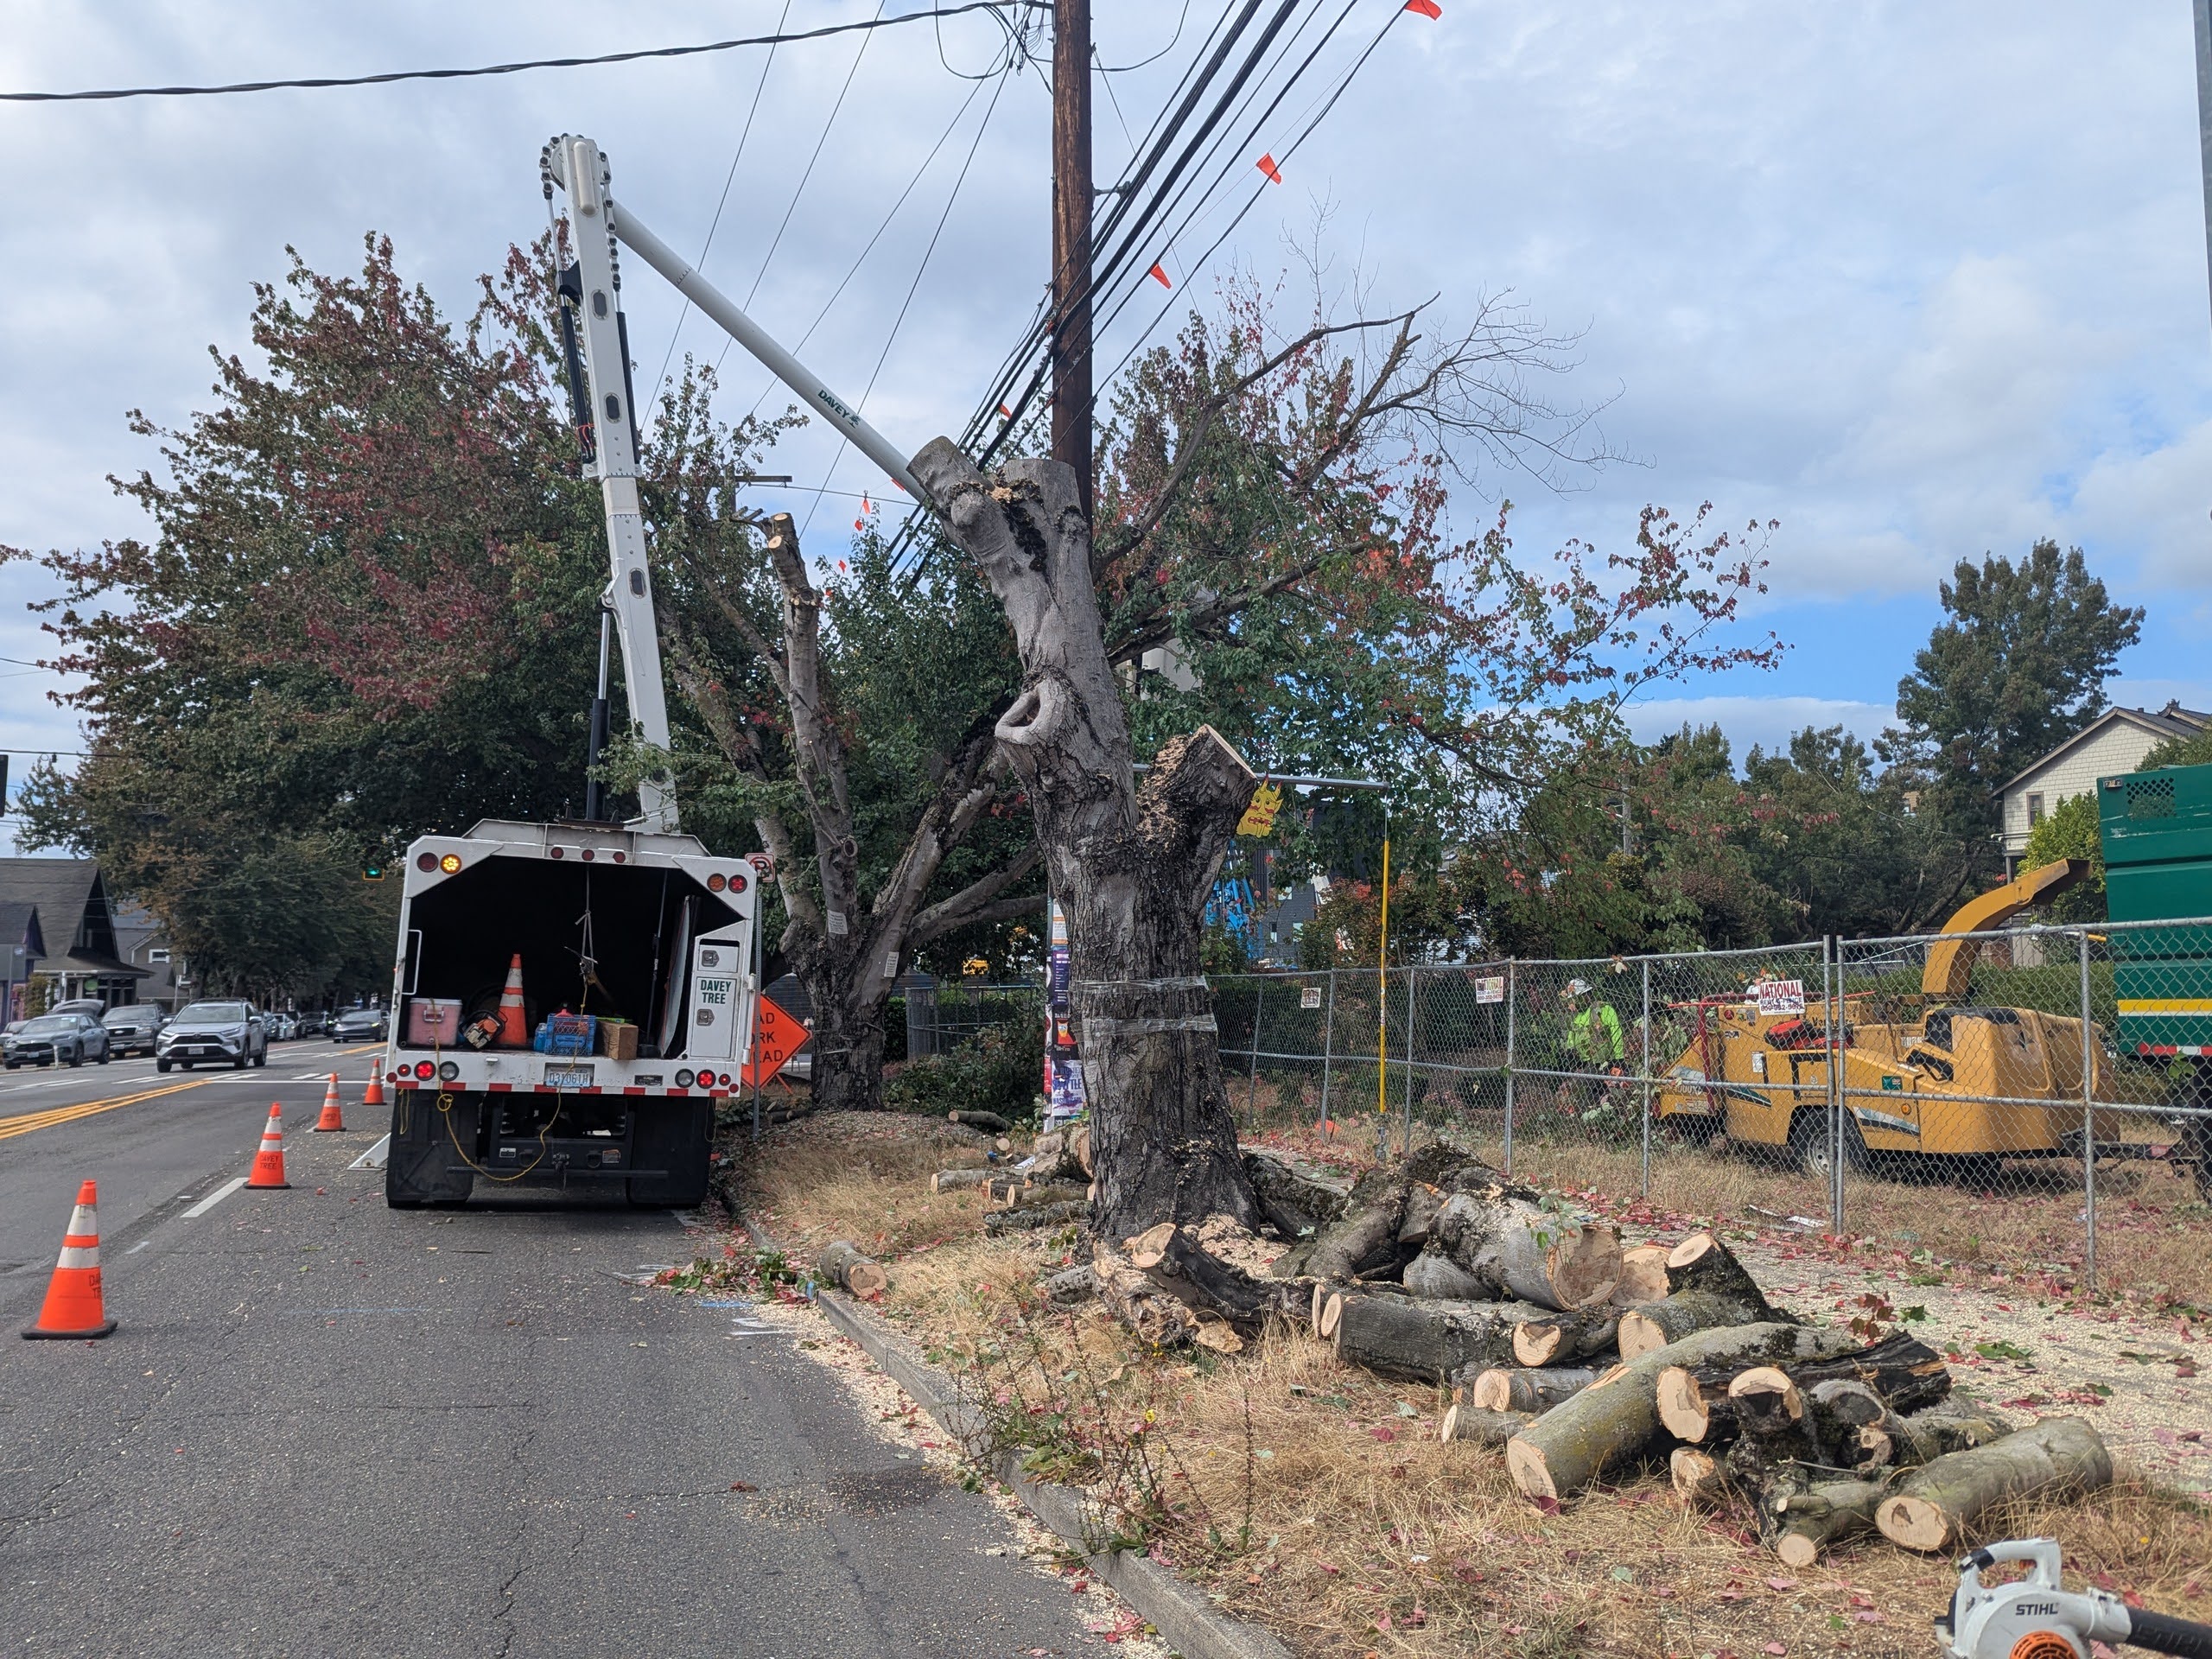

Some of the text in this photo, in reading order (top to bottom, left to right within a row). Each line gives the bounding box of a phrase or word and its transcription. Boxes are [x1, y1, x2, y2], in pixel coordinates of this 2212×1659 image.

[817, 390, 850, 419] DAVEY
[701, 979, 732, 993] DAVEY
[1759, 982, 1802, 1000] NATIONAL
[702, 992, 727, 1005] TREE
[2015, 1603, 2059, 1616] STIHL
